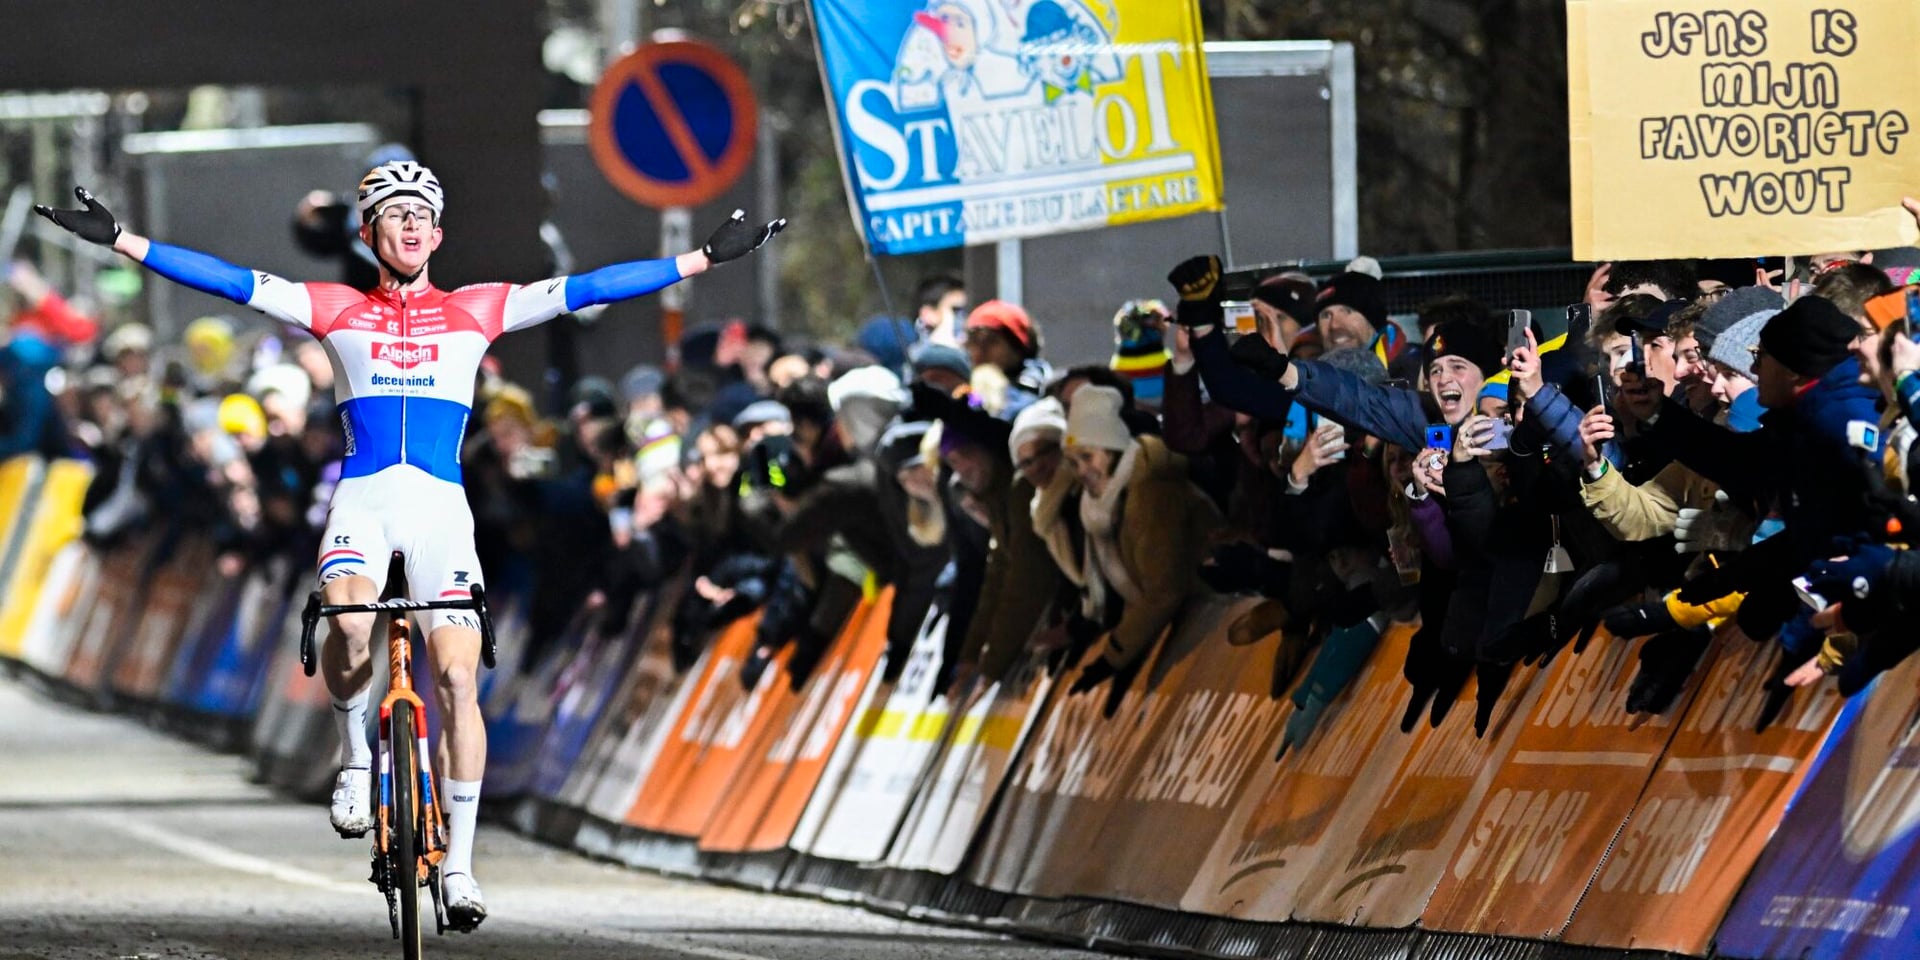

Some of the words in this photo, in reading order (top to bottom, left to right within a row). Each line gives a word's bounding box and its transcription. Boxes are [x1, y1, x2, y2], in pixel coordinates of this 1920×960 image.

[1812, 9, 1857, 57] IS
[1700, 167, 1851, 217] WOUT
[870, 203, 1015, 244] CAPITALE
[1021, 196, 1064, 227] DU
[378, 344, 432, 363] Alpecin
[371, 373, 435, 387] deceuninck
[341, 409, 354, 456] Alpecin
[1163, 691, 1290, 809] ABLOY
[1454, 786, 1591, 885] STOCK
[1601, 795, 1731, 895] STOCK
